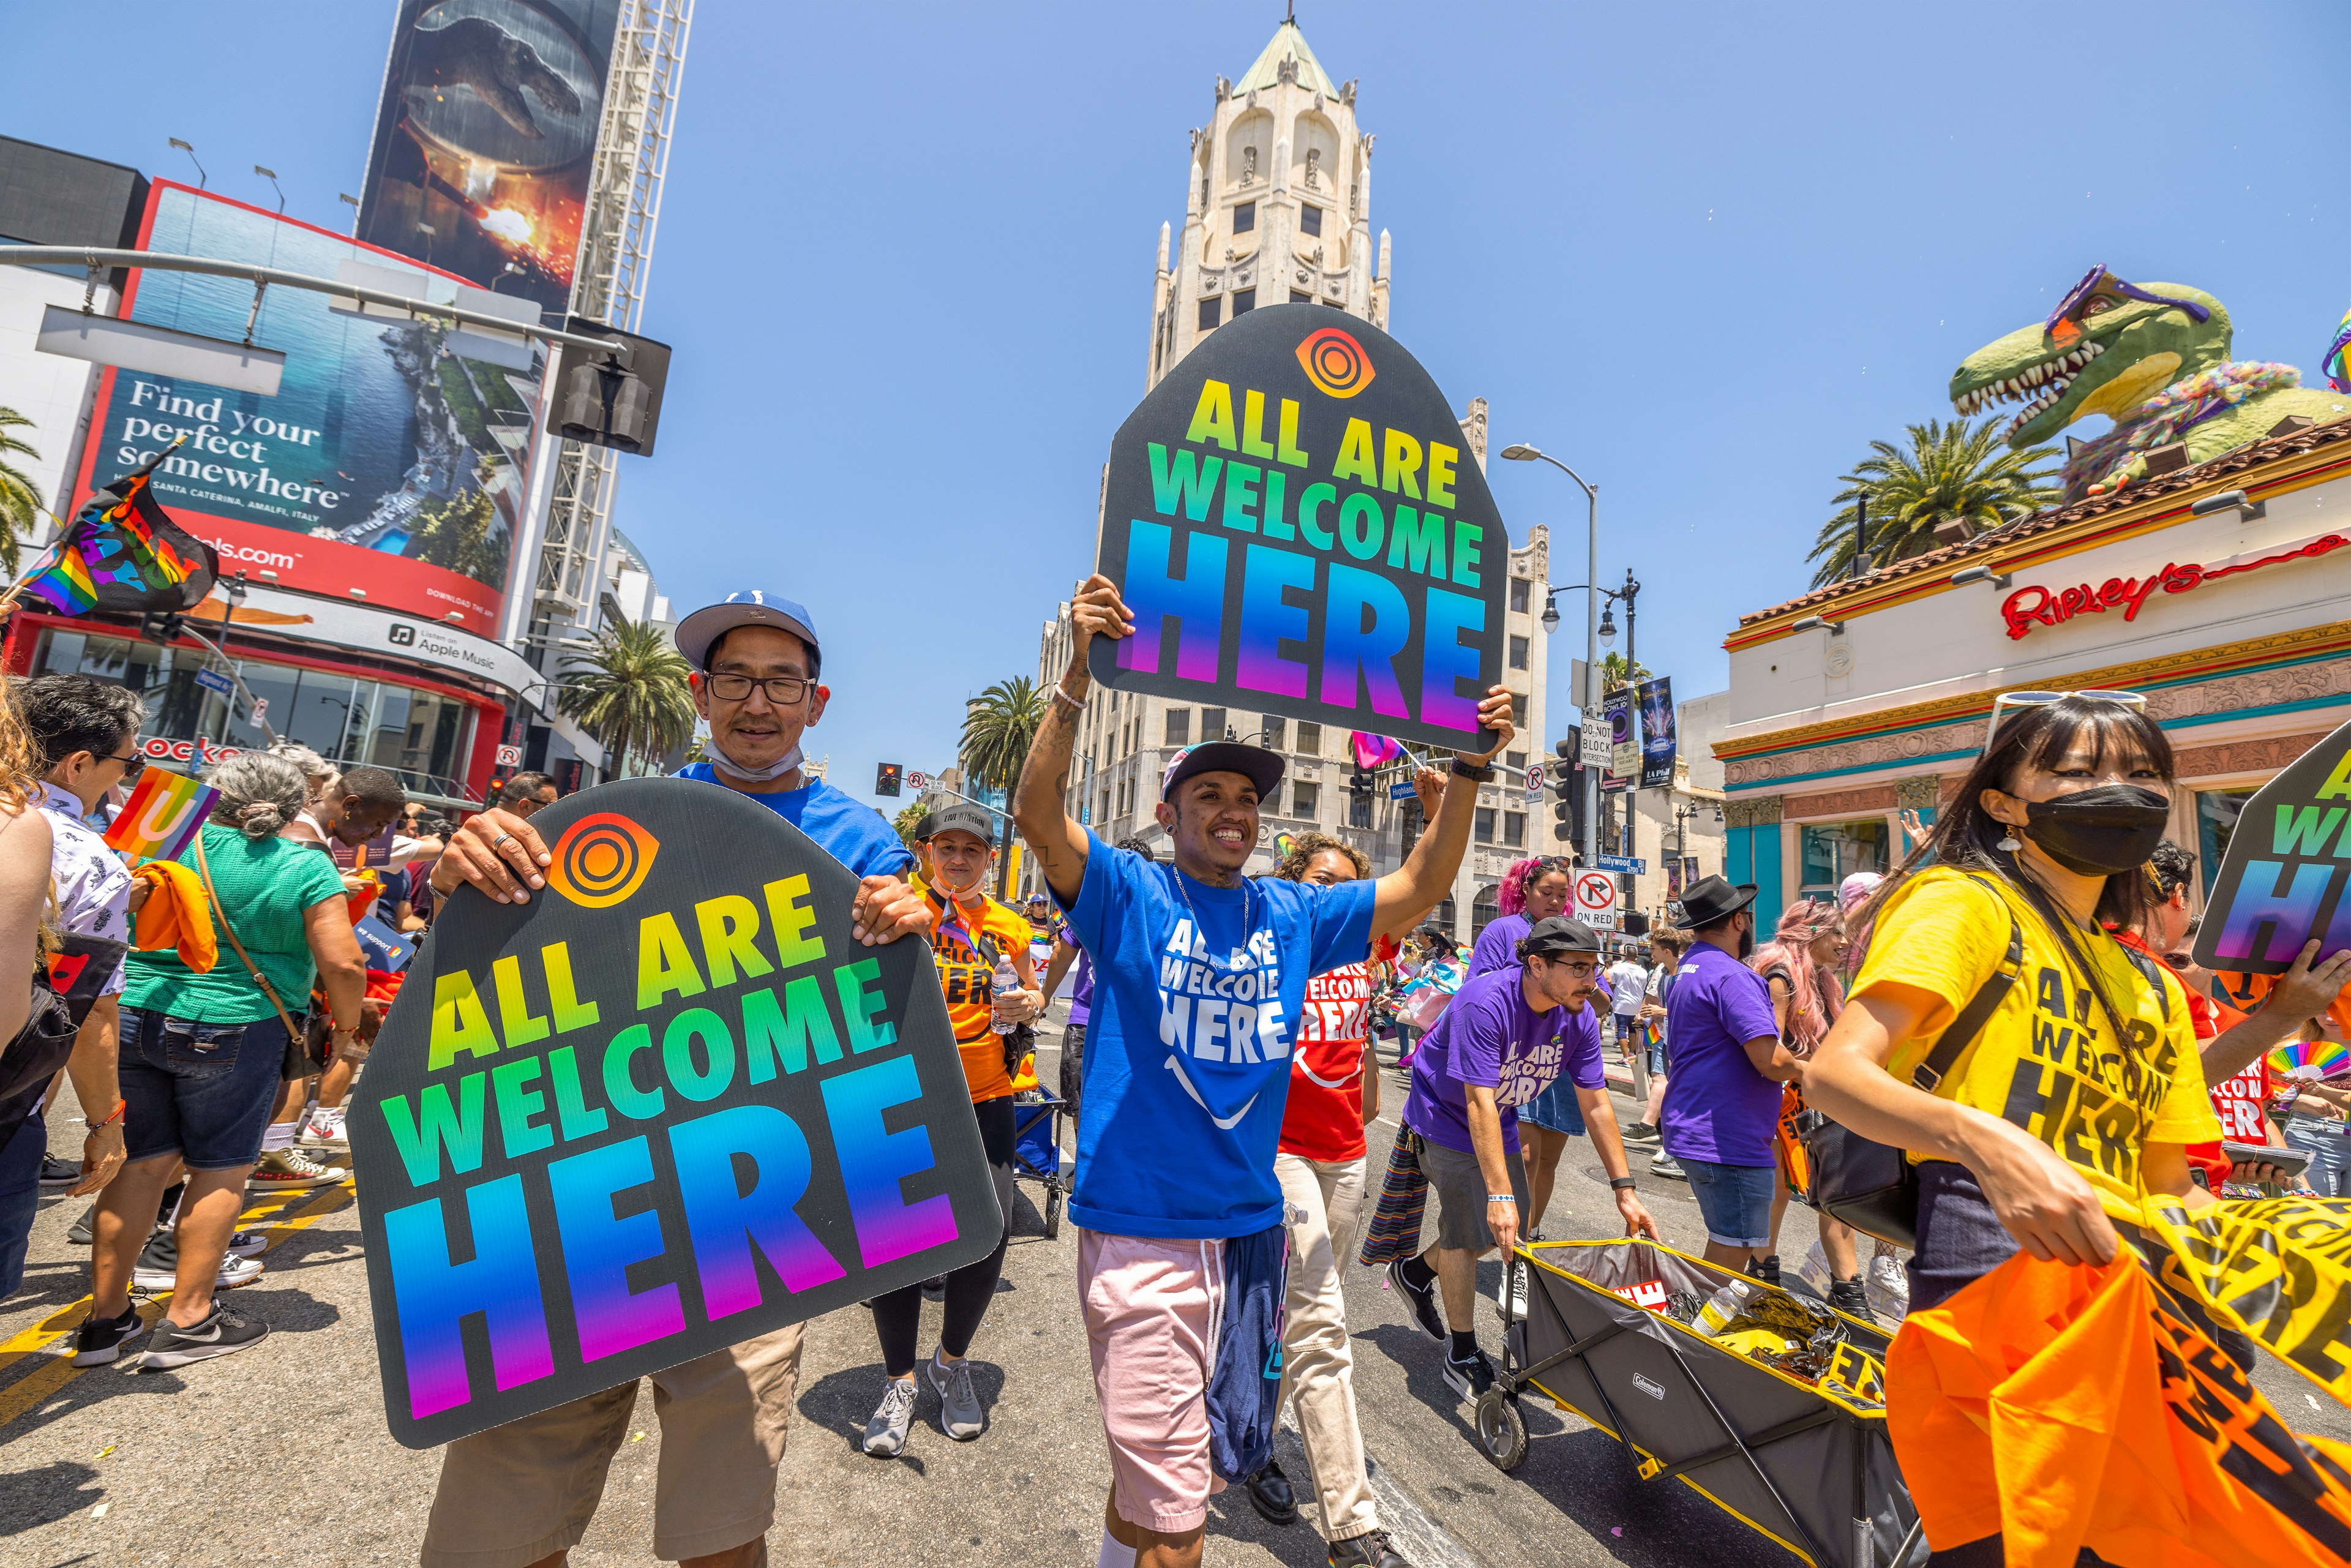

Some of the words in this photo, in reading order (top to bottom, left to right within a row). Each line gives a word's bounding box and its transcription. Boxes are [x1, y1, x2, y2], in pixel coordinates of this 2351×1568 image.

[129, 380, 223, 423] Find
[230, 410, 321, 446] your
[121, 416, 268, 463] perfect
[1185, 379, 1308, 468] ALL
[1332, 417, 1458, 509] ARE
[152, 481, 187, 495] SANTA
[190, 489, 244, 508] CATERINA,
[247, 501, 289, 517] AMALFI,
[292, 510, 320, 523] ITALY
[1148, 442, 1482, 588] WELCOME
[427, 588, 471, 608] DOWNLOAD
[472, 604, 484, 613] THE
[421, 629, 446, 642] Listen
[1116, 519, 1486, 733] HERE
[419, 639, 459, 658] Apple
[462, 650, 495, 670] Music
[1603, 703, 1620, 713] BOWL
[1583, 724, 1592, 735] DO
[1597, 726, 1611, 738] NOT
[1582, 752, 1611, 764] INTERSECTION
[1583, 739, 1611, 754] BLOCK
[944, 813, 959, 823] LIVE
[959, 812, 984, 828] NATION
[1599, 855, 1630, 867] Hollywood
[1577, 912, 1591, 923] ON
[1594, 913, 1613, 925] RED
[357, 926, 368, 936] we
[366, 932, 391, 951] support
[427, 942, 599, 1071] ALL
[637, 873, 826, 1010] ARE
[1158, 988, 1290, 1064] HERE
[1524, 1043, 1564, 1065] ARE
[380, 957, 898, 1188] WELCOME
[384, 1053, 959, 1420] HERE
[1635, 1373, 1657, 1394] Coleman
